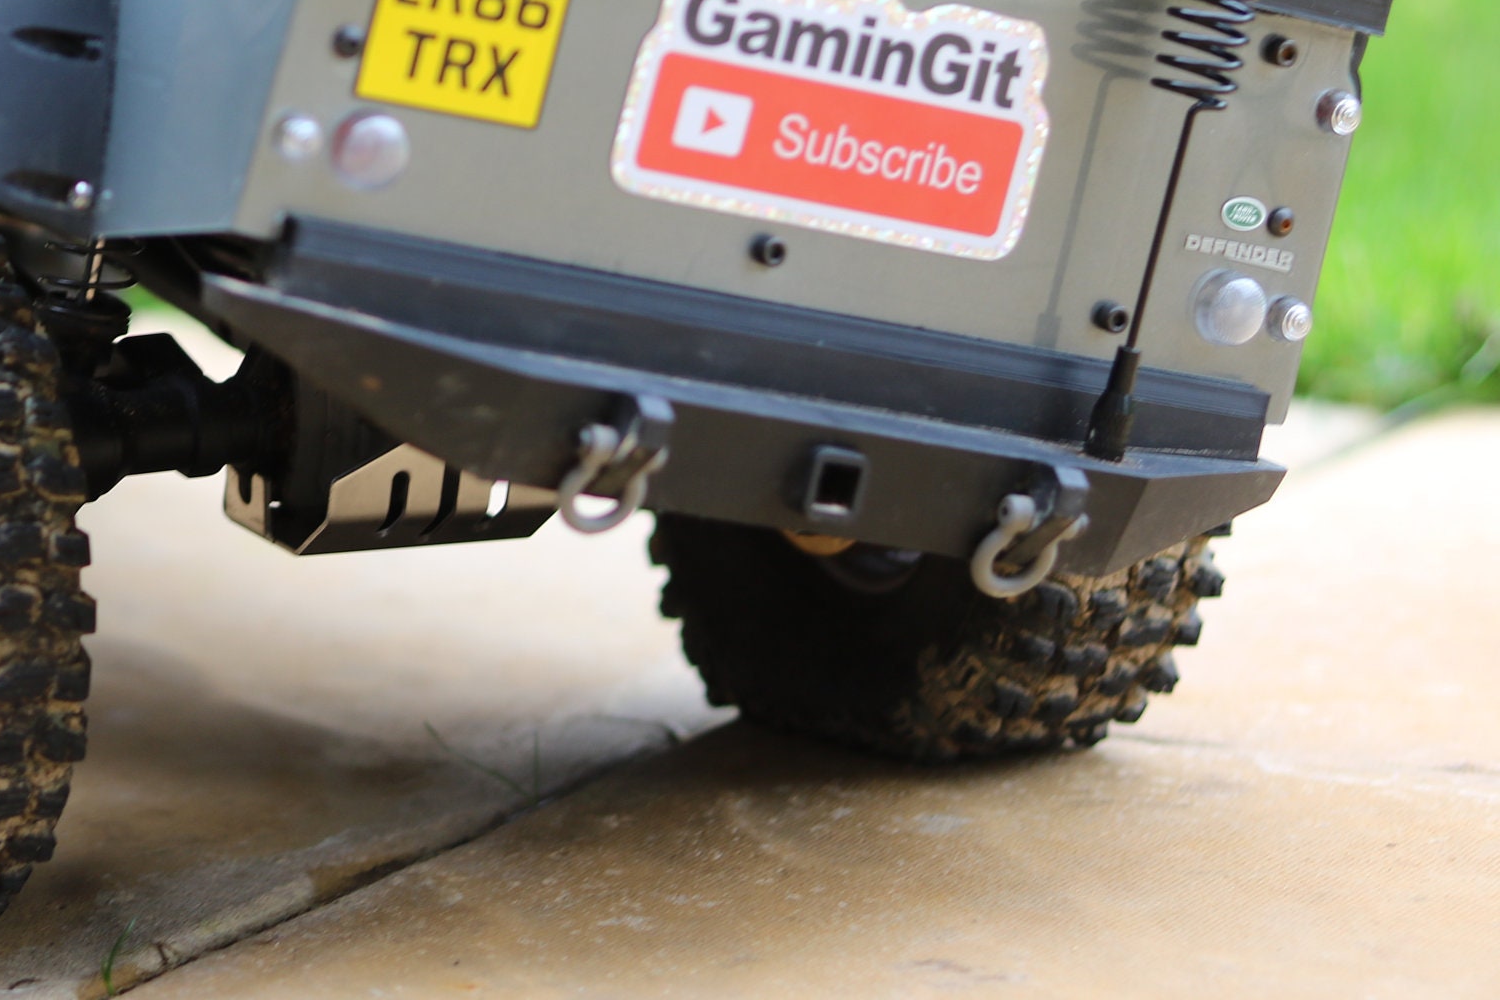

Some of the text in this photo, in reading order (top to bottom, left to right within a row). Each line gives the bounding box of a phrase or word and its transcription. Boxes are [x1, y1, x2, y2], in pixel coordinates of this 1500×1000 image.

[405, 28, 521, 97] TRX
[773, 113, 983, 195] Subscribe
[1185, 233, 1295, 272] DEFENDER
